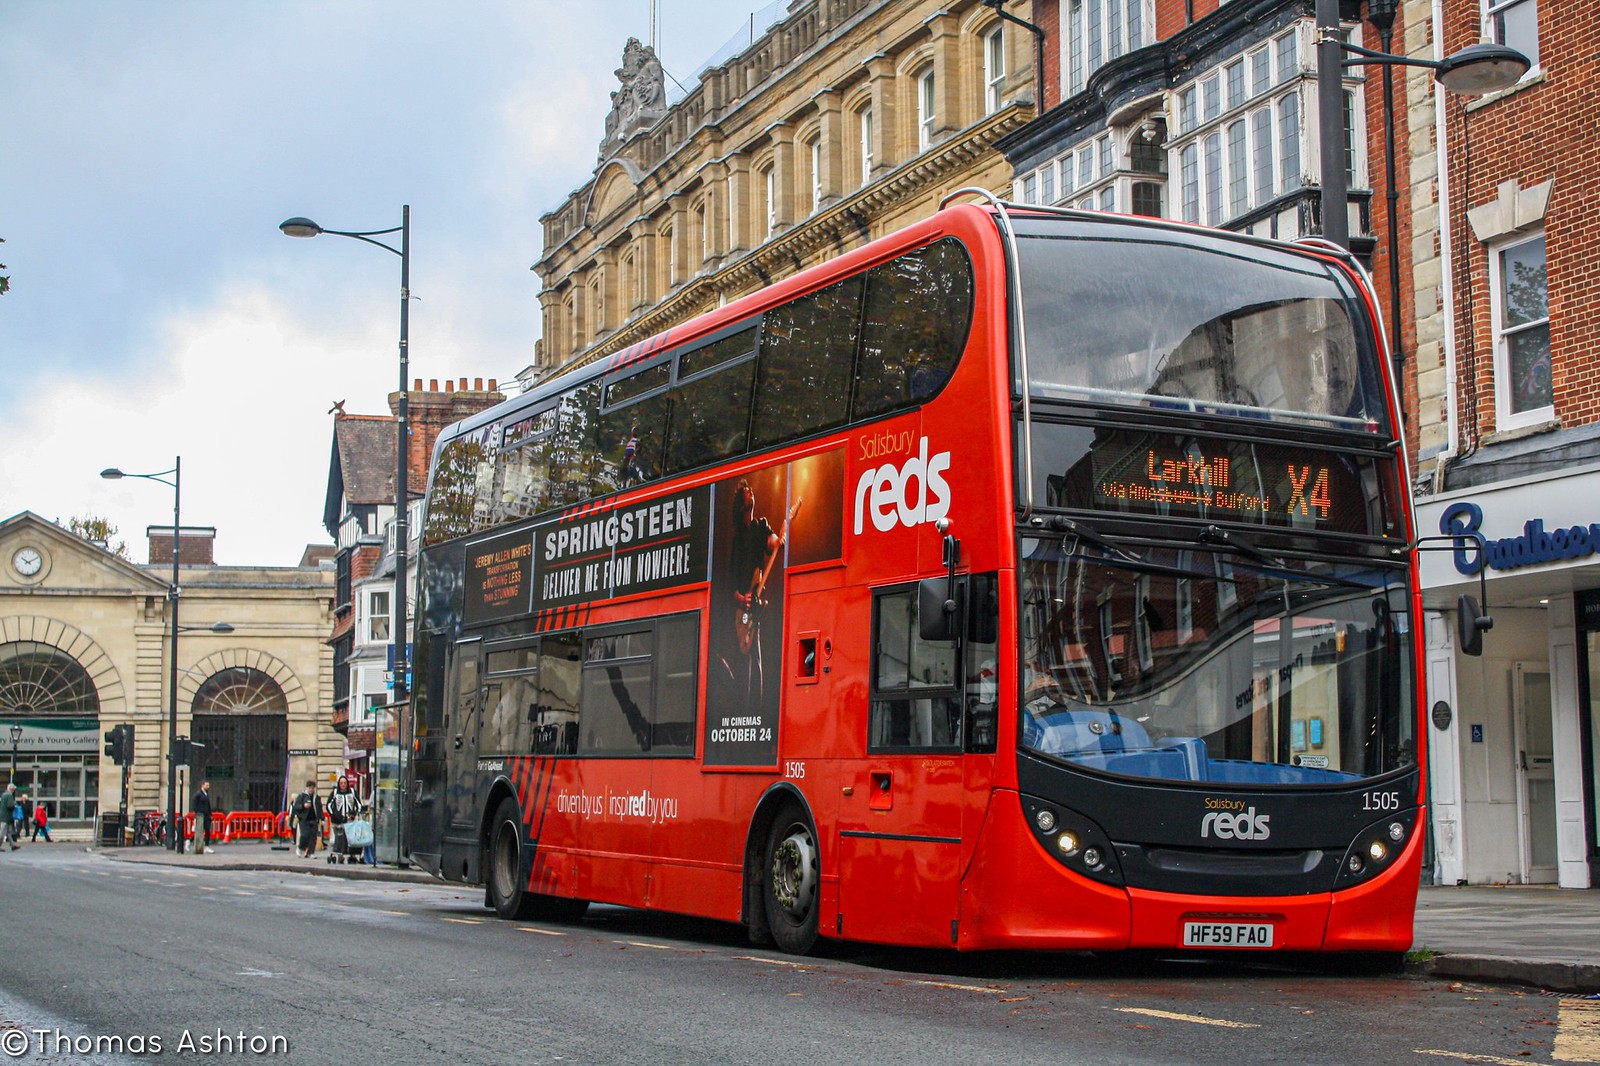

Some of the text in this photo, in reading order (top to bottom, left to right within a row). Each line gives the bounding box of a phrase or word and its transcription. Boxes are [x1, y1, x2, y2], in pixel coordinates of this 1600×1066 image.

[859, 429, 915, 461] Salisbury
[1148, 450, 1229, 487] Larkhill
[854, 435, 951, 536] reds
[1102, 481, 1125, 499] via
[1216, 491, 1270, 512] Bulford
[1287, 464, 1331, 517] X4
[544, 496, 693, 561] SPRINGSTEEN
[495, 549, 511, 564] ALLEN
[511, 543, 532, 559] WHITE'S
[508, 570, 522, 584] LESS
[542, 543, 691, 600] DELIVER ME FROM NOWHERE
[721, 716, 762, 727] IN CINEMAS
[10, 736, 35, 746] Lrary
[46, 736, 71, 745] Young
[72, 736, 99, 745] Gallery
[711, 728, 772, 742] OCTOBER 24
[785, 761, 806, 779] 1505
[557, 788, 678, 824] driven by us inspired by you
[1204, 797, 1246, 811] Salisbury
[1362, 791, 1400, 811] 1505
[1200, 806, 1271, 841] reds
[1190, 925, 1267, 944] HF59 FAO
